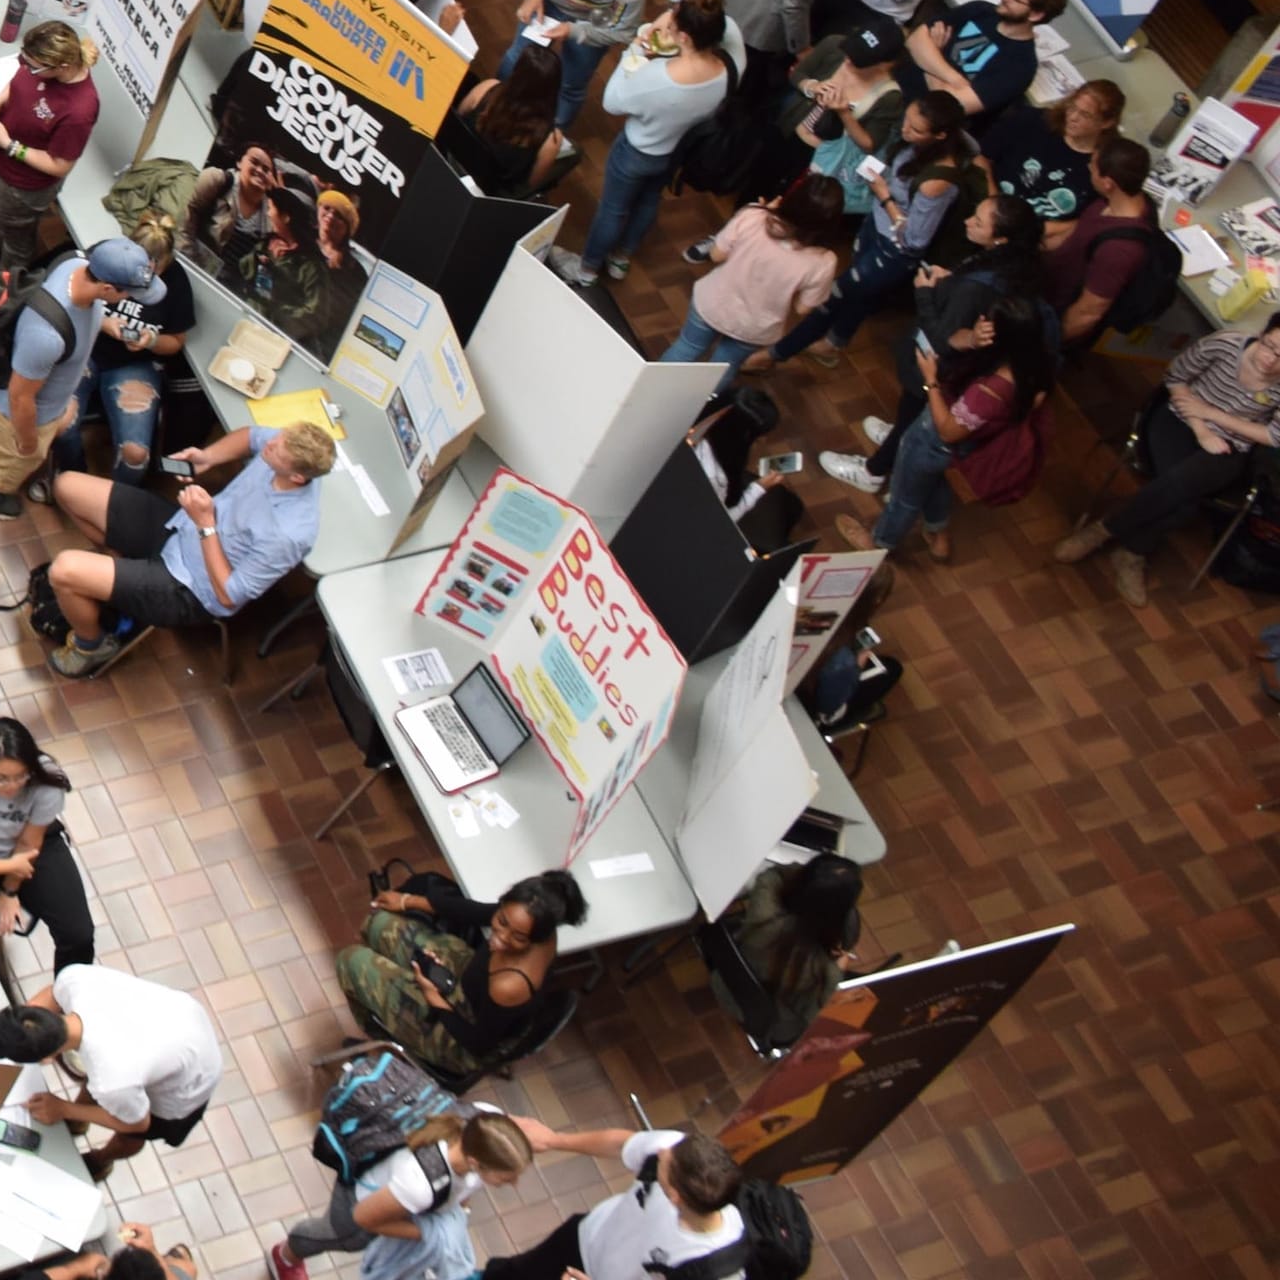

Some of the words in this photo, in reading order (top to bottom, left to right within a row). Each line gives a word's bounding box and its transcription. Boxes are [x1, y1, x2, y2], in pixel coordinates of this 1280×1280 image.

[247, 50, 406, 199] DISCOVER
[265, 96, 366, 187] JESUS
[289, 56, 384, 147] COME
[116, 299, 145, 317] THE
[537, 561, 640, 727] Buddies
[561, 527, 651, 661] Best
